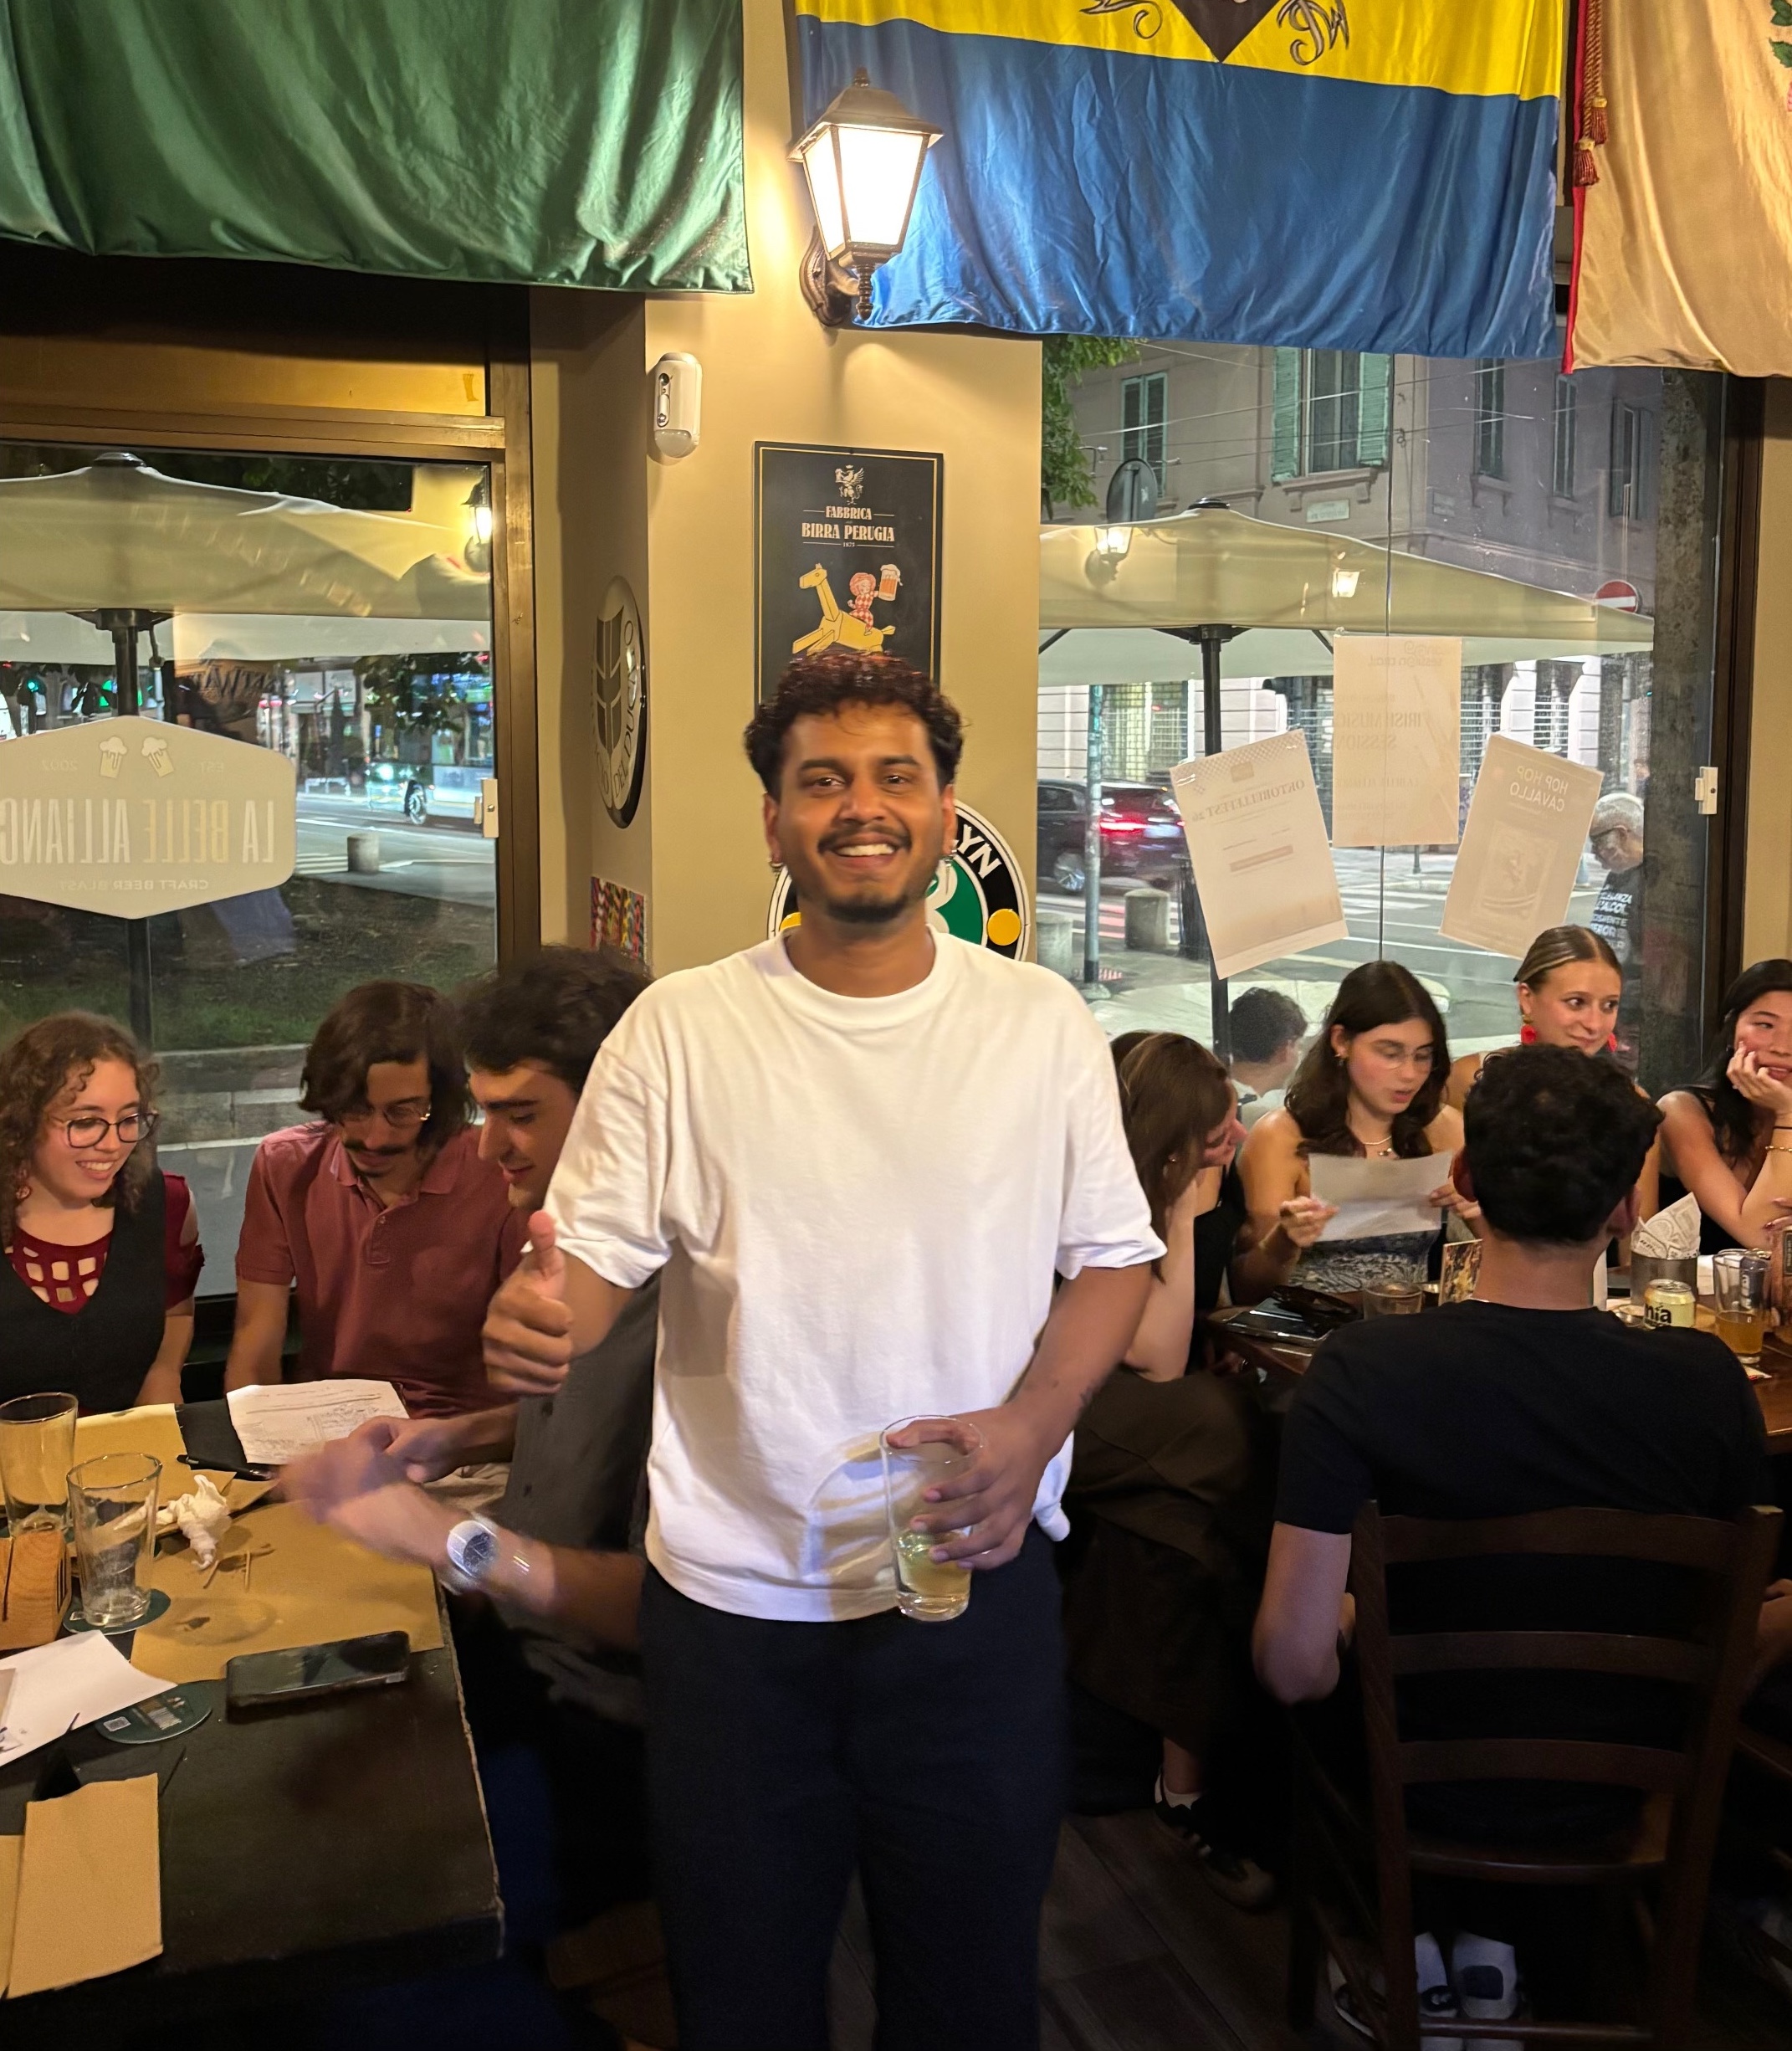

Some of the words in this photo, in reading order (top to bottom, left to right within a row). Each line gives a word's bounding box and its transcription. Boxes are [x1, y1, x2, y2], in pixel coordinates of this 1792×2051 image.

[825, 505, 873, 520] FABBRICA
[801, 522, 841, 540] BIRRA
[844, 524, 895, 542] PERUGIA
[952, 823, 1002, 879] YN
